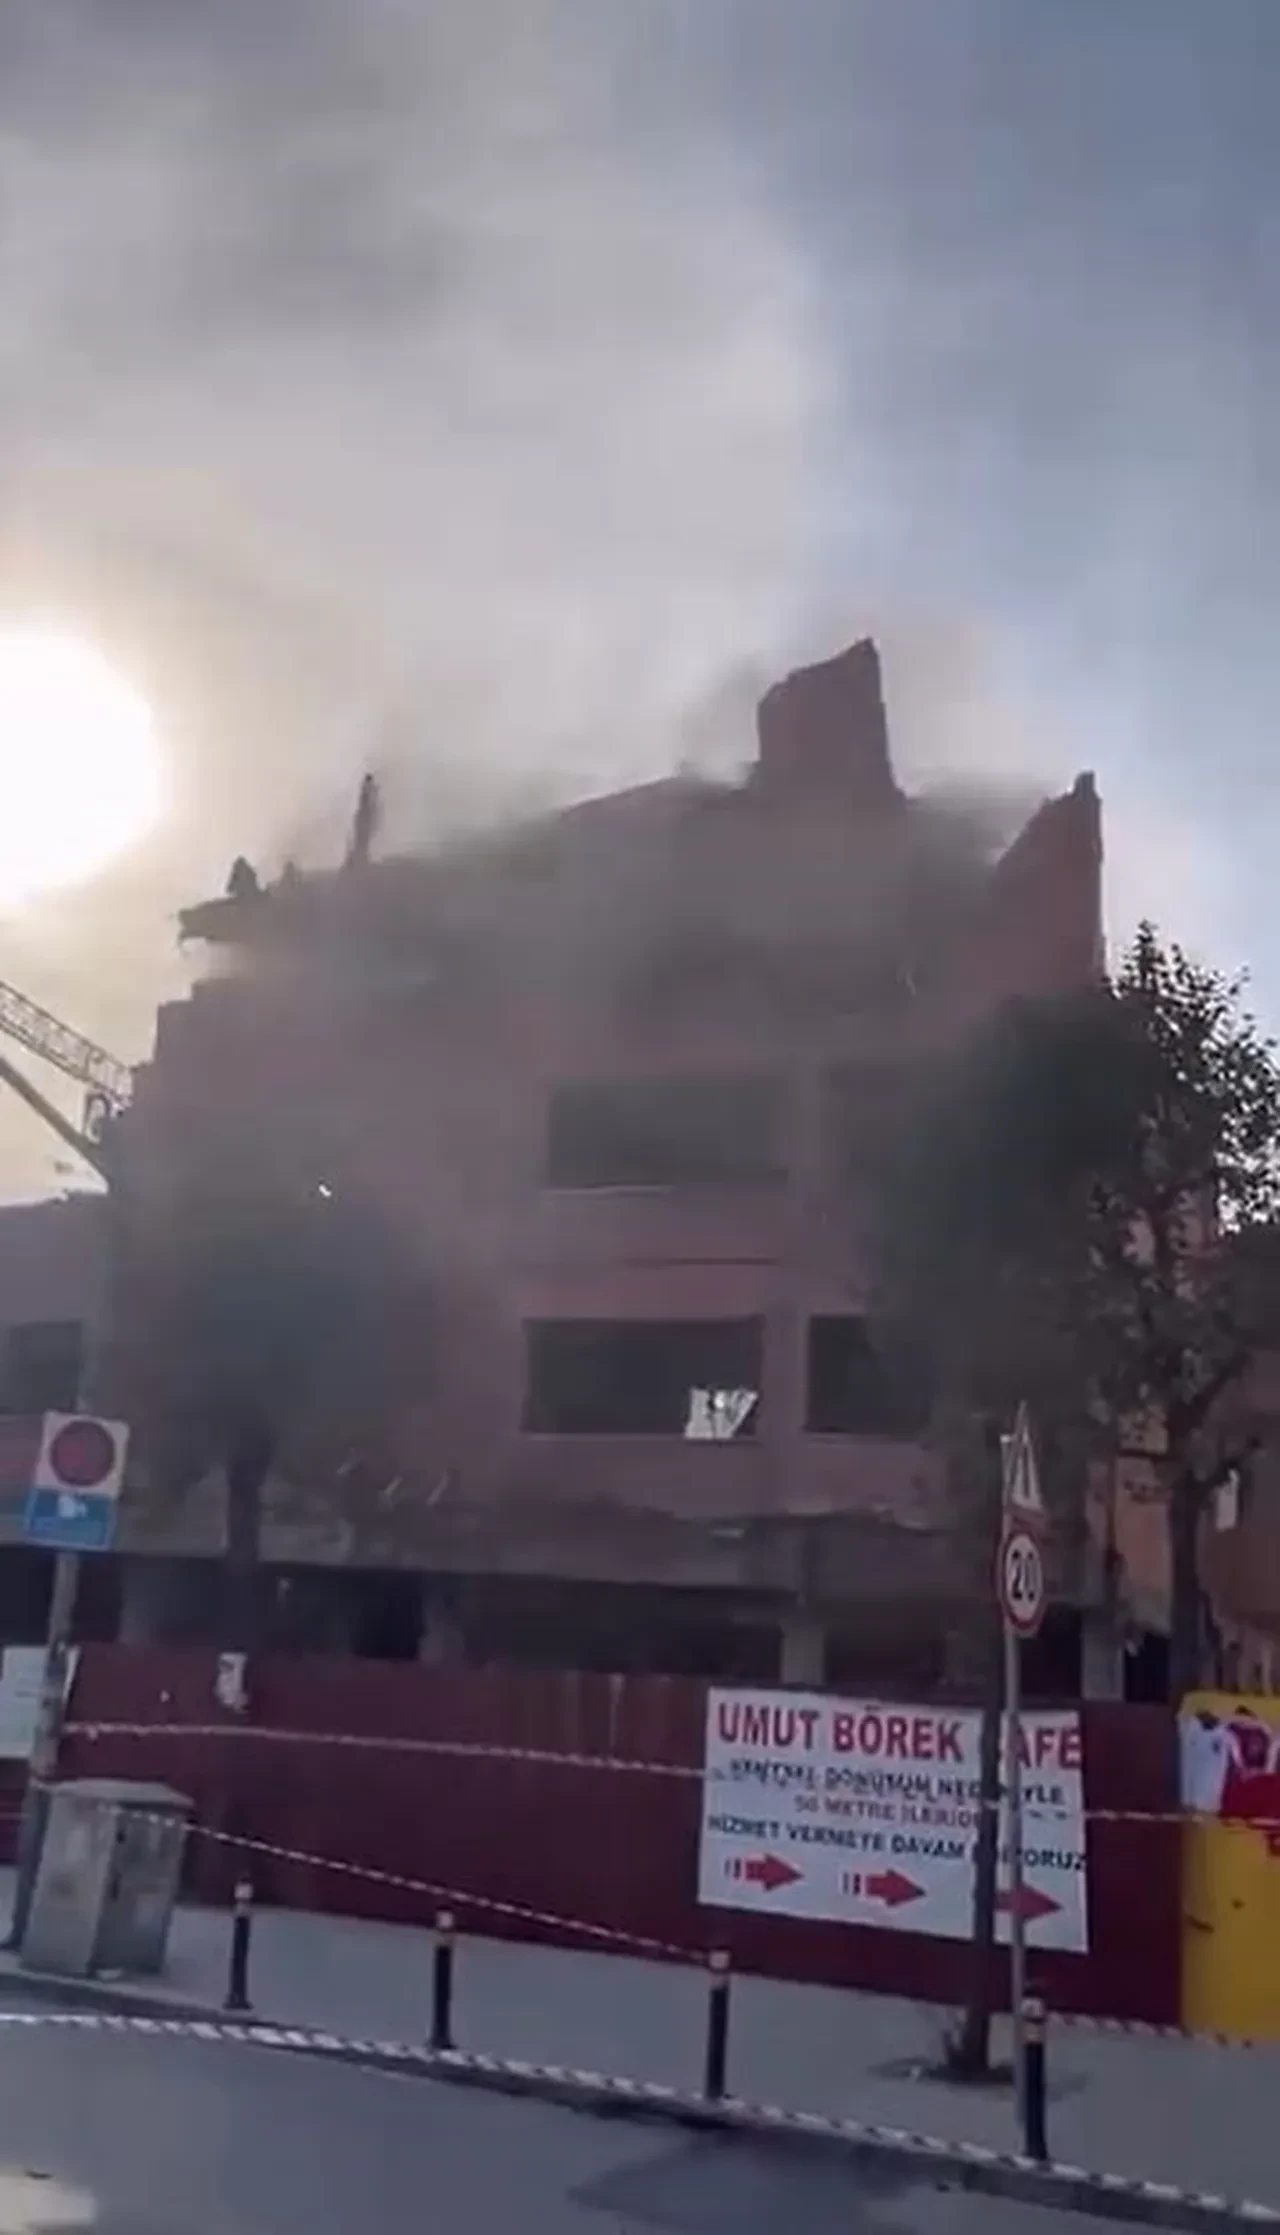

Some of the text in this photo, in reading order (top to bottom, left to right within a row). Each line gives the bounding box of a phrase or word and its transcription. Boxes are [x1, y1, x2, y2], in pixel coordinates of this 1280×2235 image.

[1011, 1549, 1038, 1601] 20
[718, 1702, 1083, 1770] UMUT BÖREK AFE
[891, 1832, 965, 1858] DAVAM
